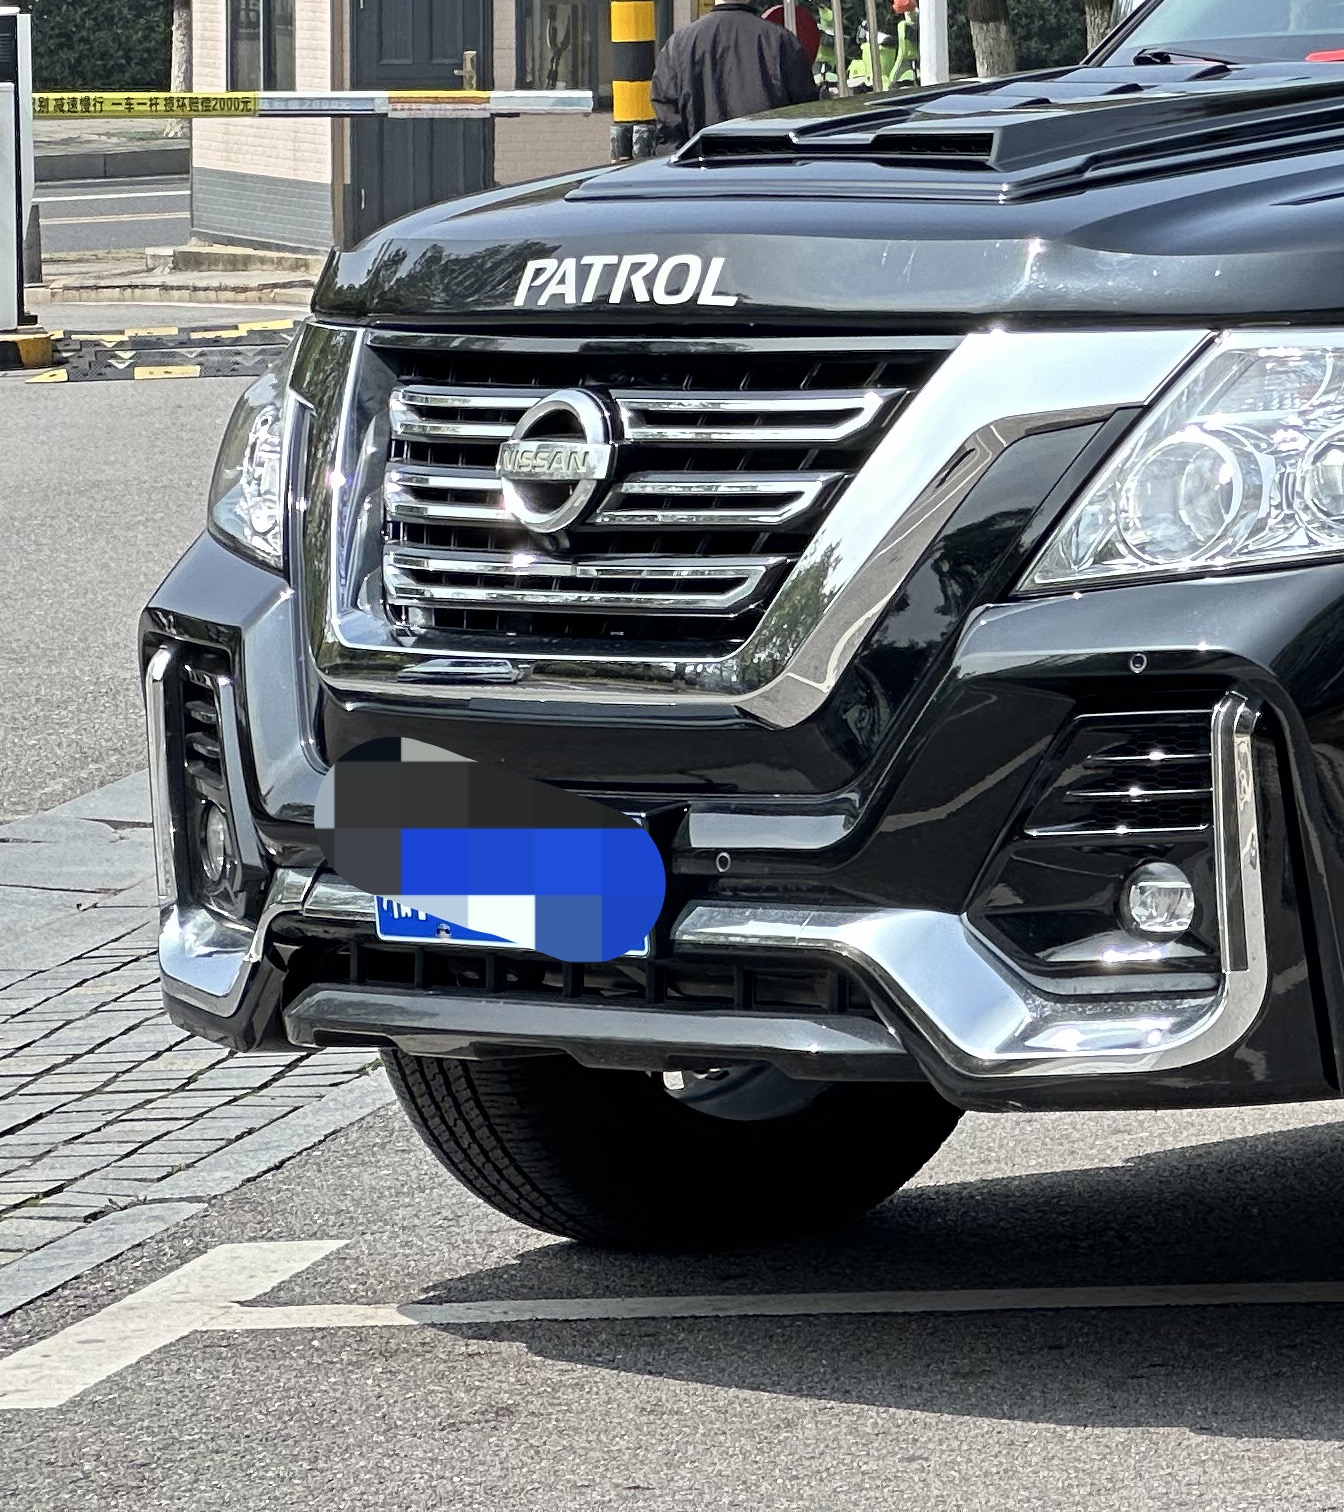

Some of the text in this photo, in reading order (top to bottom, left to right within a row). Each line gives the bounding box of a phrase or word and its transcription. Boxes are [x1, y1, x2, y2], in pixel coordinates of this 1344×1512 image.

[53, 96, 104, 113] 减速慢行
[111, 96, 160, 113] 一车一杆
[163, 96, 252, 113] 损坏赔偿2000元
[513, 253, 738, 306] PATROL
[501, 449, 589, 472] NISSAN
